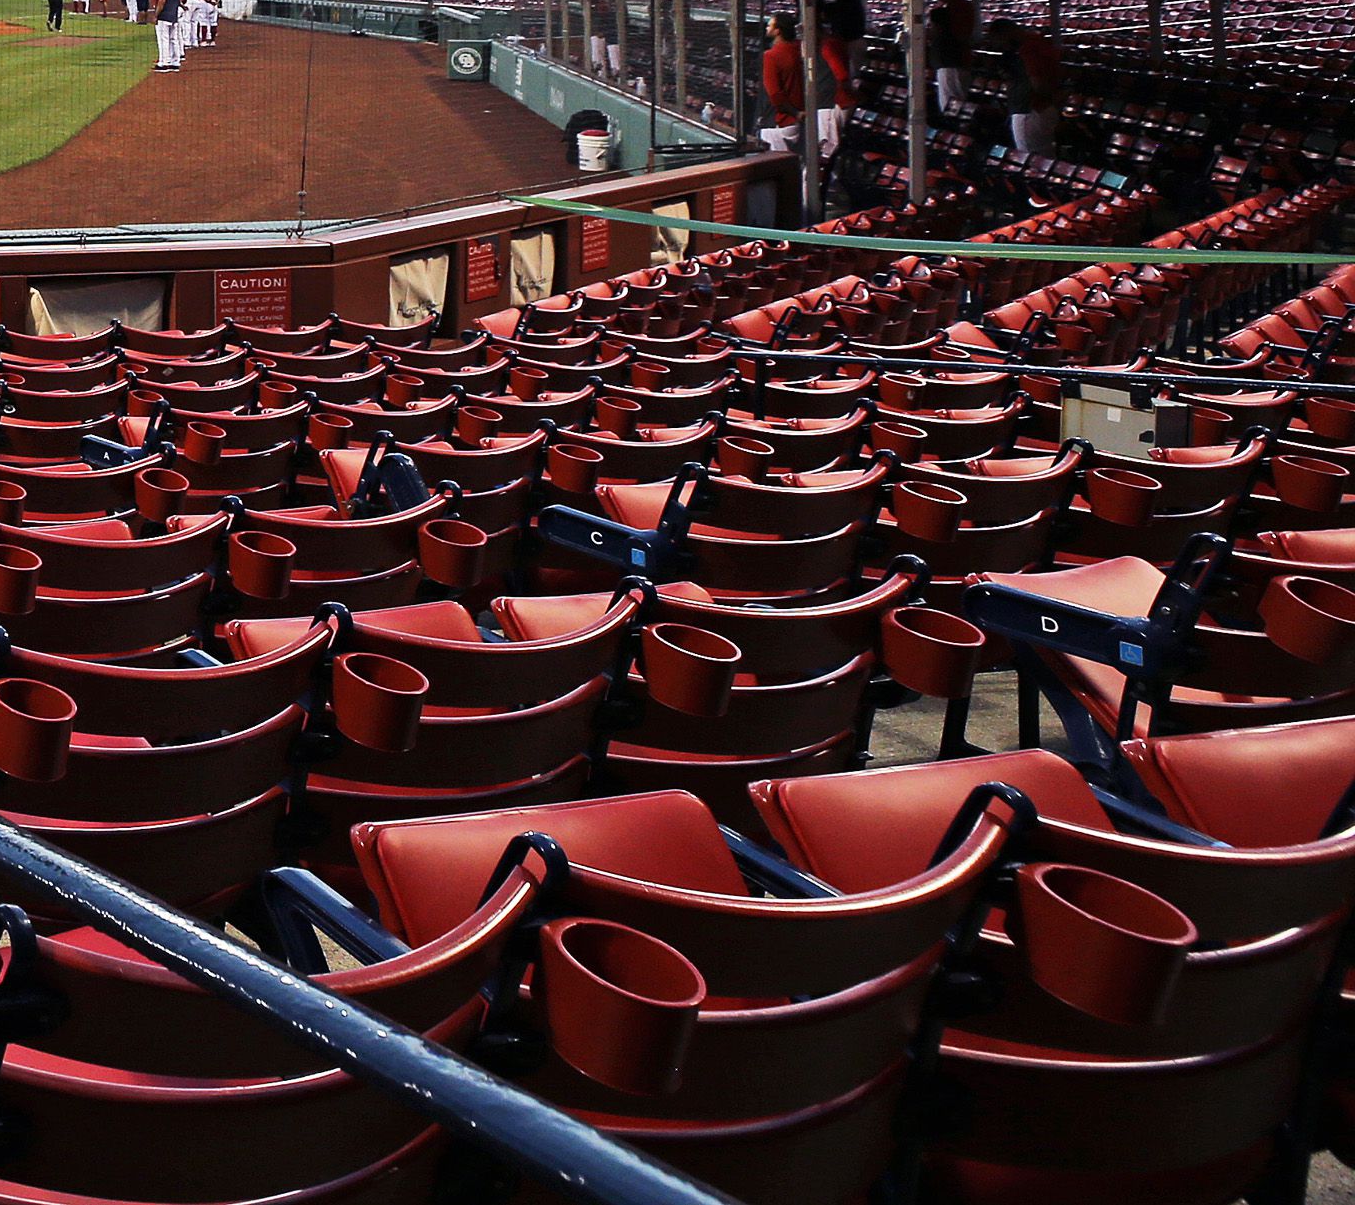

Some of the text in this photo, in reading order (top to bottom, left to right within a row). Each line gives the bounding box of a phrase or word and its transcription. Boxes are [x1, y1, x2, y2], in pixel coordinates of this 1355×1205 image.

[220, 277, 287, 289] CAUTION!
[103, 452, 110, 461] A
[590, 531, 604, 545] C
[1041, 615, 1059, 633] D
